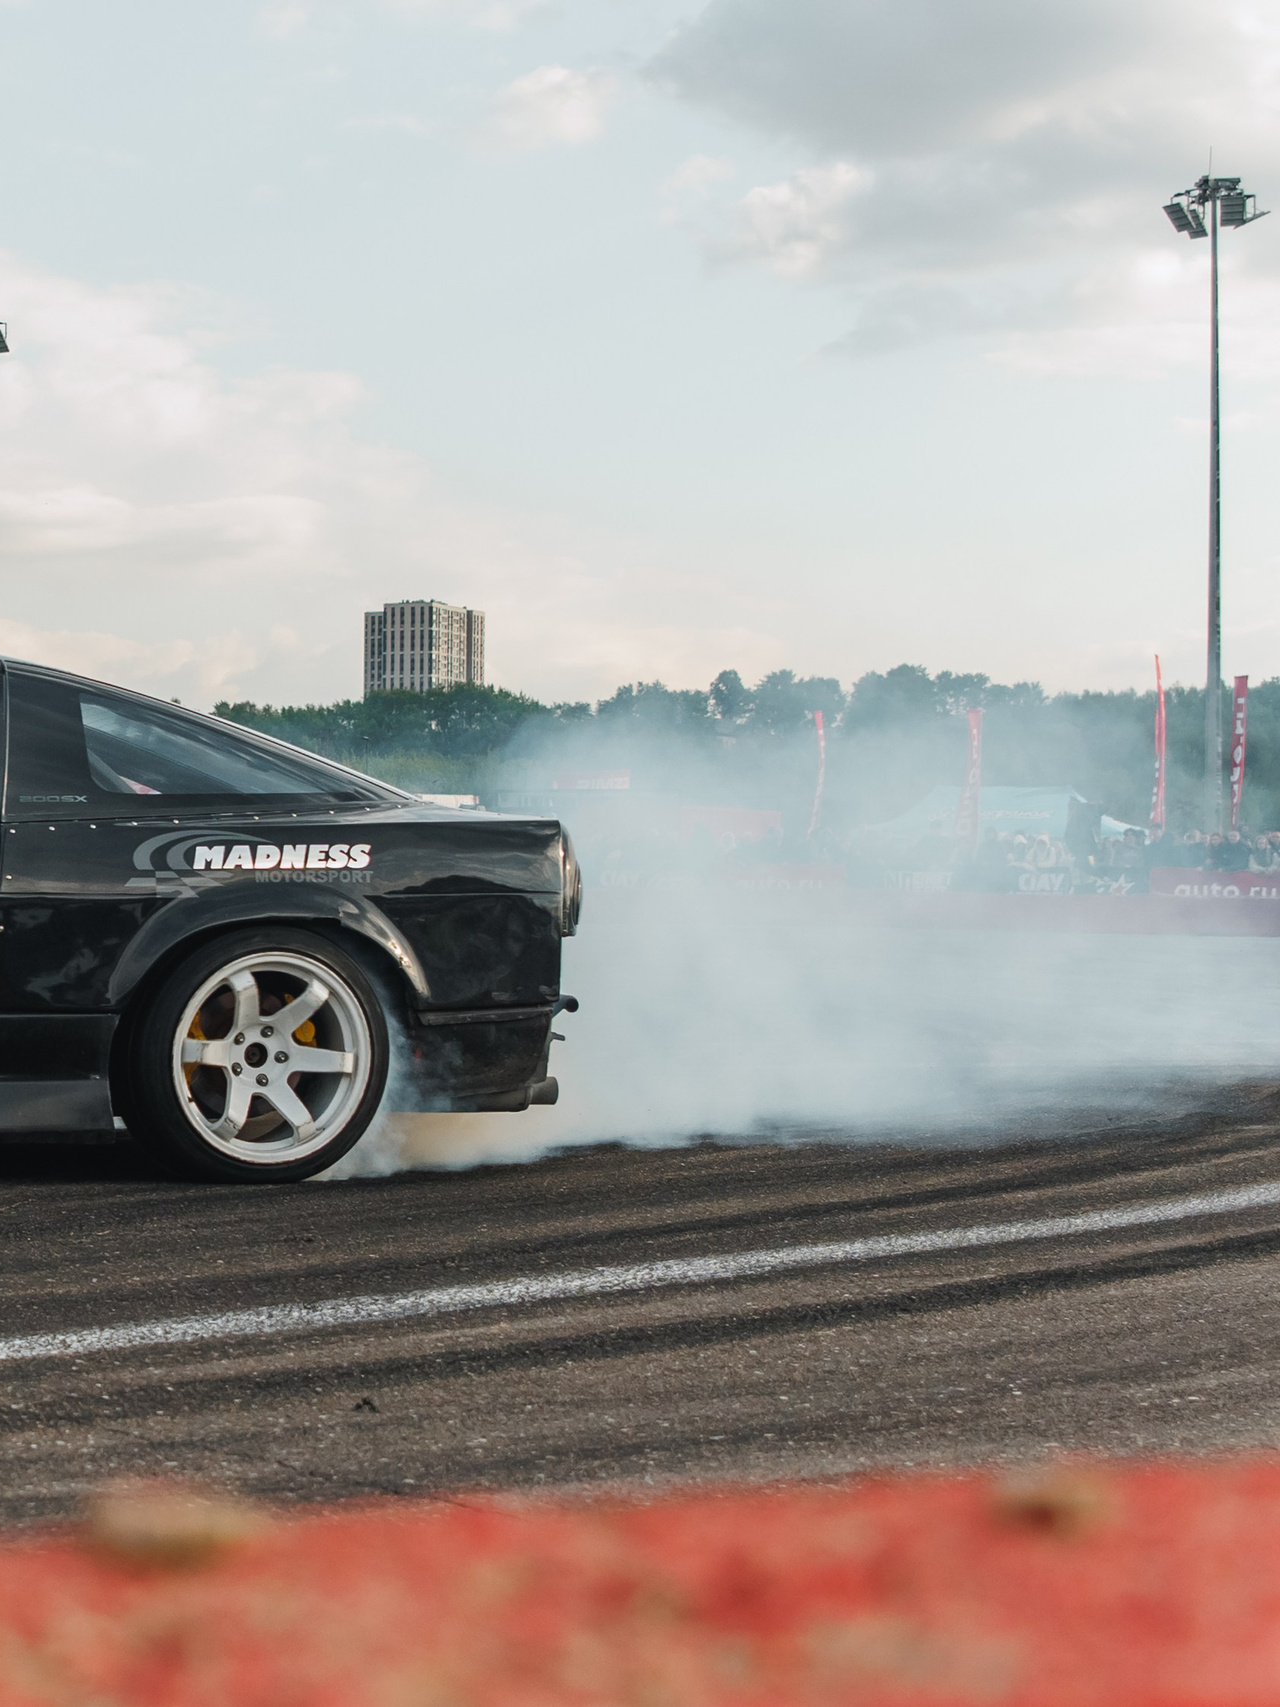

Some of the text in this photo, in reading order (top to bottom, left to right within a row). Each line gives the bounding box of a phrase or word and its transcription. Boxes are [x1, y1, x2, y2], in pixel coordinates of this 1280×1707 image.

[19, 795, 88, 803] 200SX
[192, 843, 372, 870] MADNESS
[255, 870, 374, 883] MOTORSPORT
[1174, 882, 1277, 898] autoru
